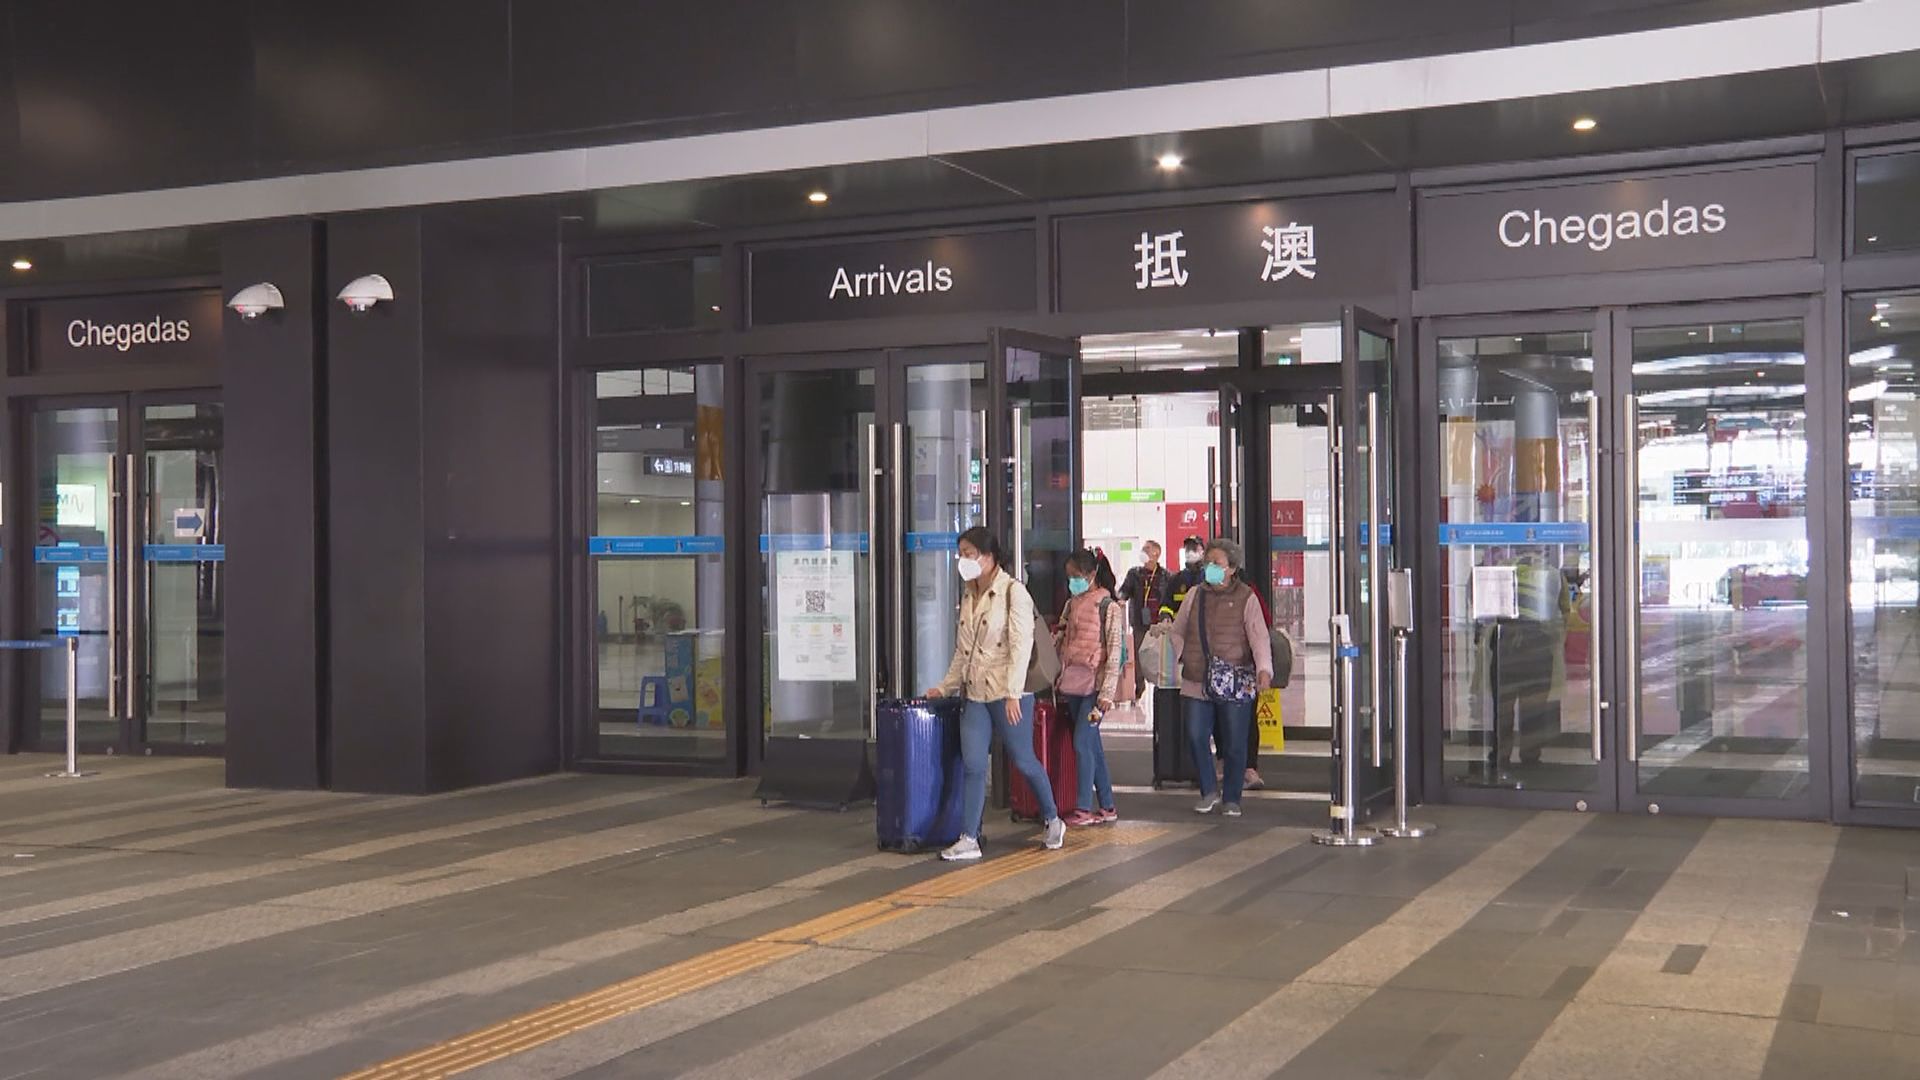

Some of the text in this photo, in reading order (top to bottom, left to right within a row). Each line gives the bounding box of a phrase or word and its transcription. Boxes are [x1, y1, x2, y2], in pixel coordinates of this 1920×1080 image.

[1498, 198, 1727, 252] Chegadas
[1134, 222, 1317, 290] 抵澳
[829, 260, 953, 300] Arrivals
[67, 315, 191, 353] Chegadas
